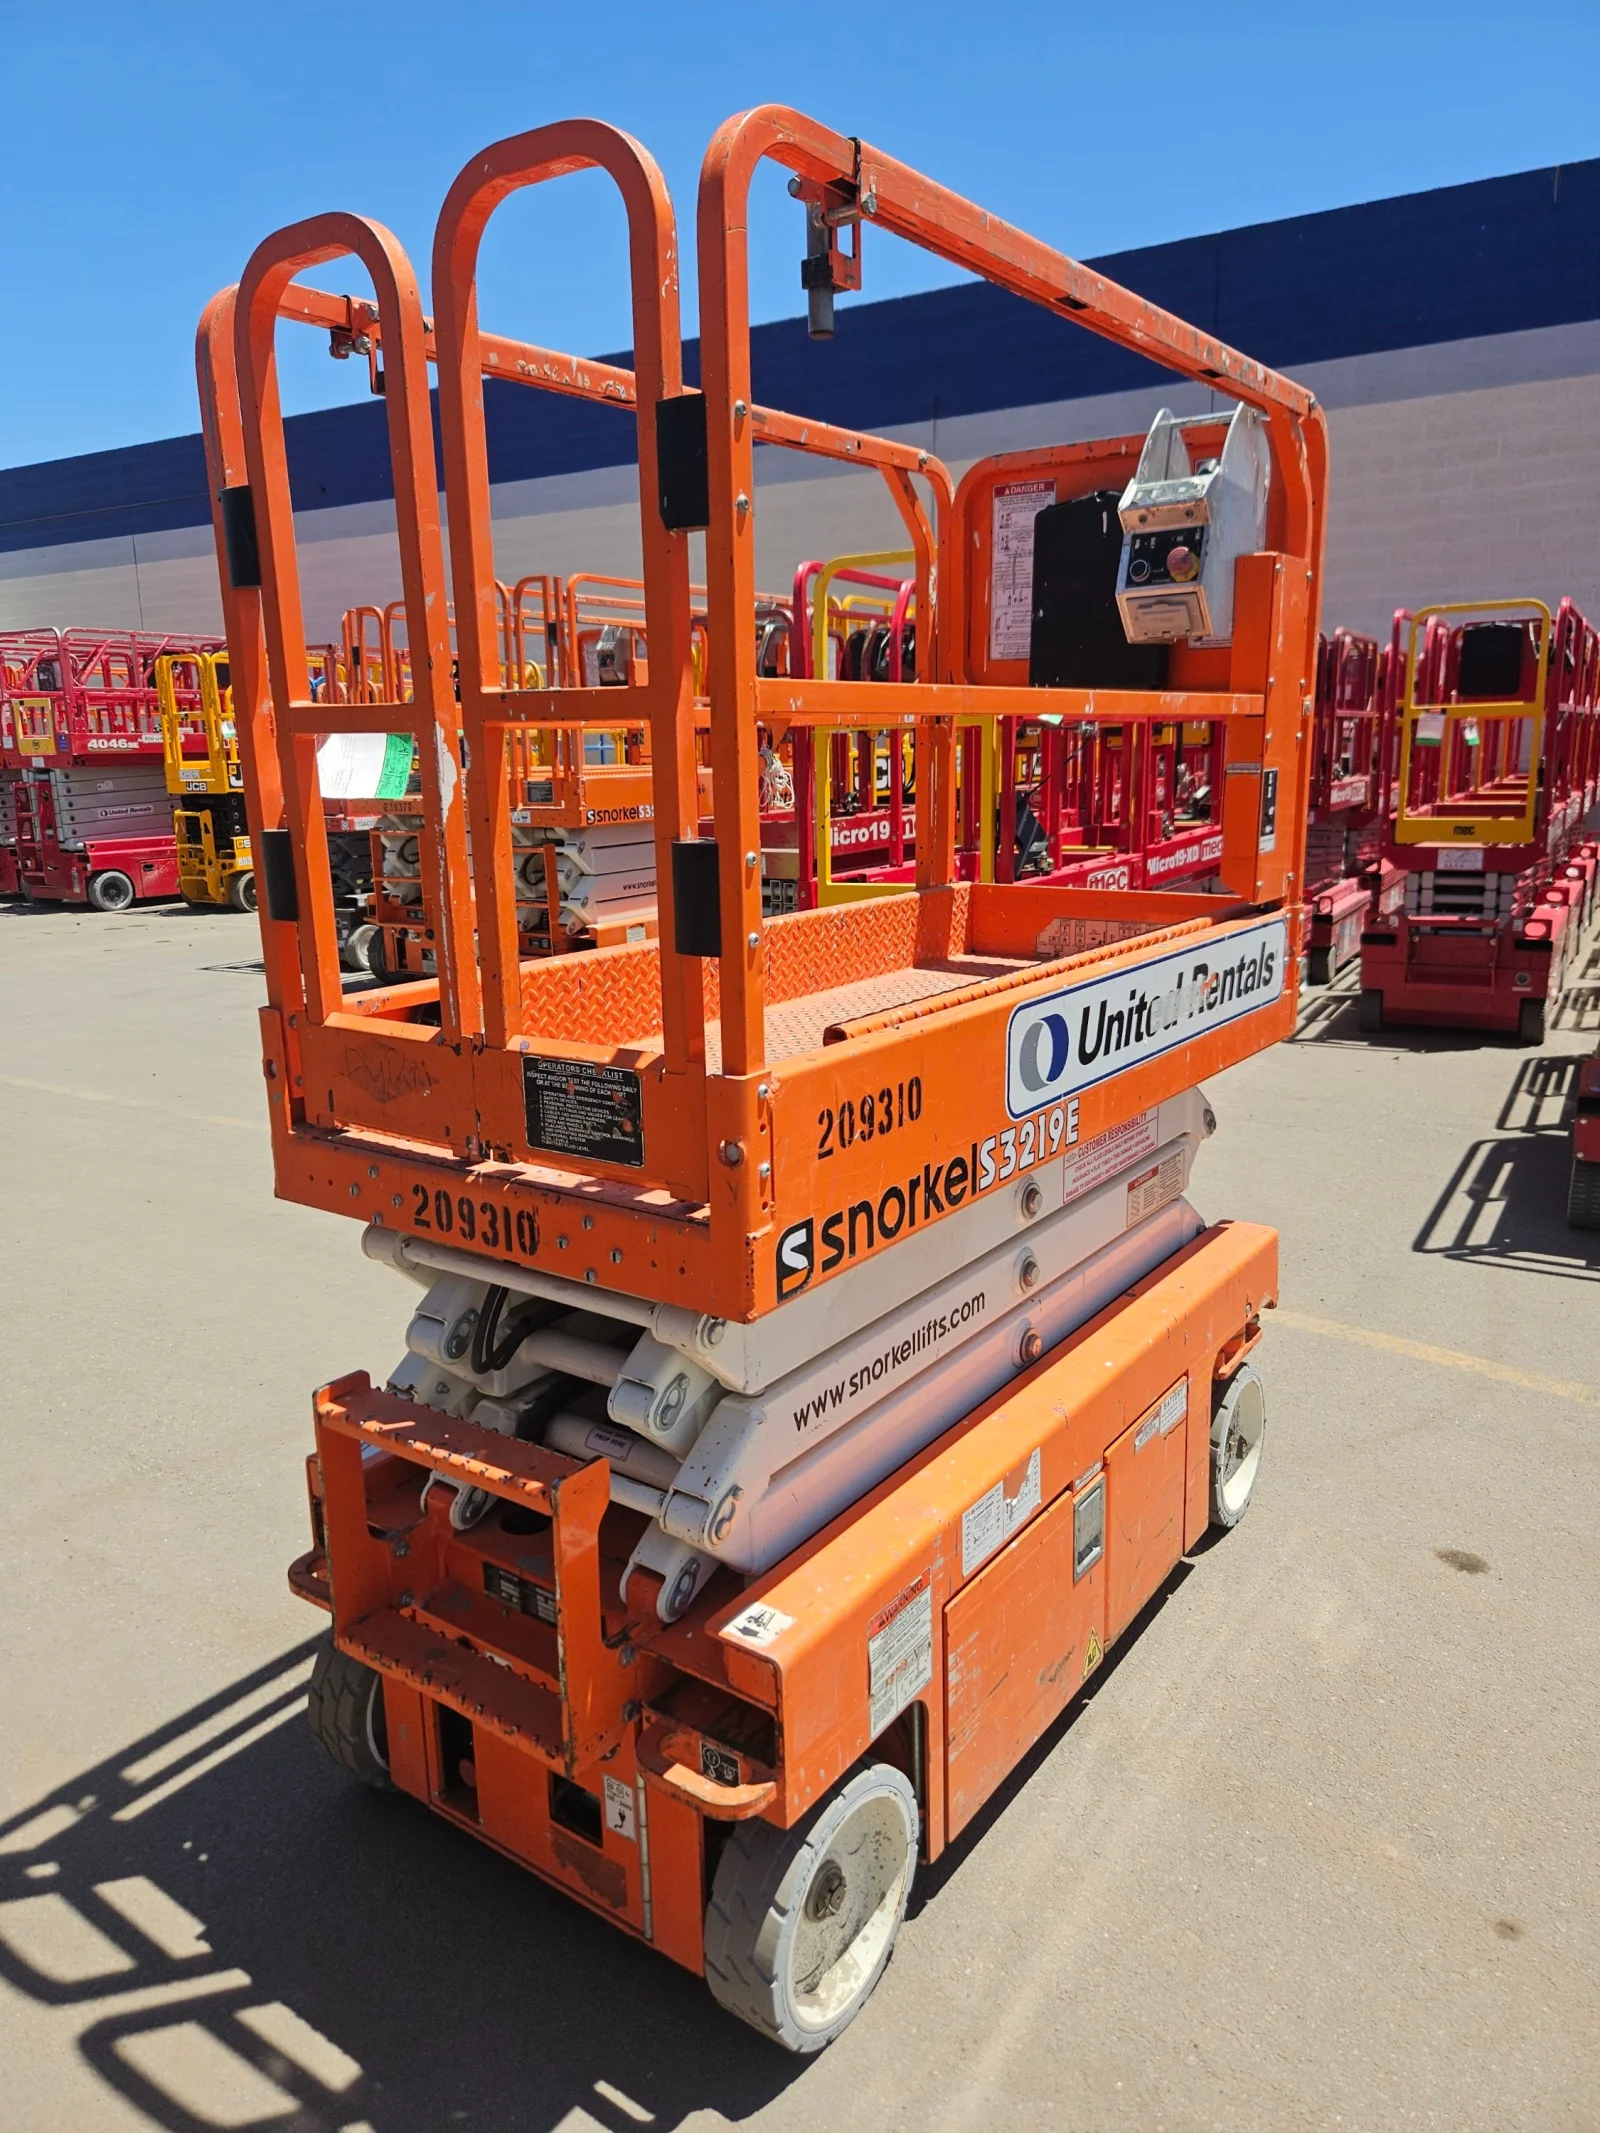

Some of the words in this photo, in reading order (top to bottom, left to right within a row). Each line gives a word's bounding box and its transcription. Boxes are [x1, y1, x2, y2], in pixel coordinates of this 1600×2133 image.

[1010, 483, 1045, 495] DANGER
[186, 782, 208, 792] JCB
[108, 808, 129, 816] United
[130, 806, 152, 814] Rentals
[829, 820, 891, 847] icro19
[1453, 825, 1475, 836] mec
[1089, 870, 1127, 890] mec
[538, 1060, 580, 1073] OPERATORS
[581, 1067, 623, 1079] CHEKLIST
[817, 1076, 922, 1160] 209310
[1078, 1133, 1109, 1158] CUSTOMER
[1108, 1112, 1148, 1141] RESPONSIBILITY
[412, 1183, 541, 1257] 209310
[792, 1291, 985, 1432] wwwsnorkellifts.com
[1163, 1388, 1184, 1411] BATTERY
[595, 1433, 610, 1442] PROP
[610, 1439, 626, 1449] HERE
[884, 1579, 924, 1622] WARNING
